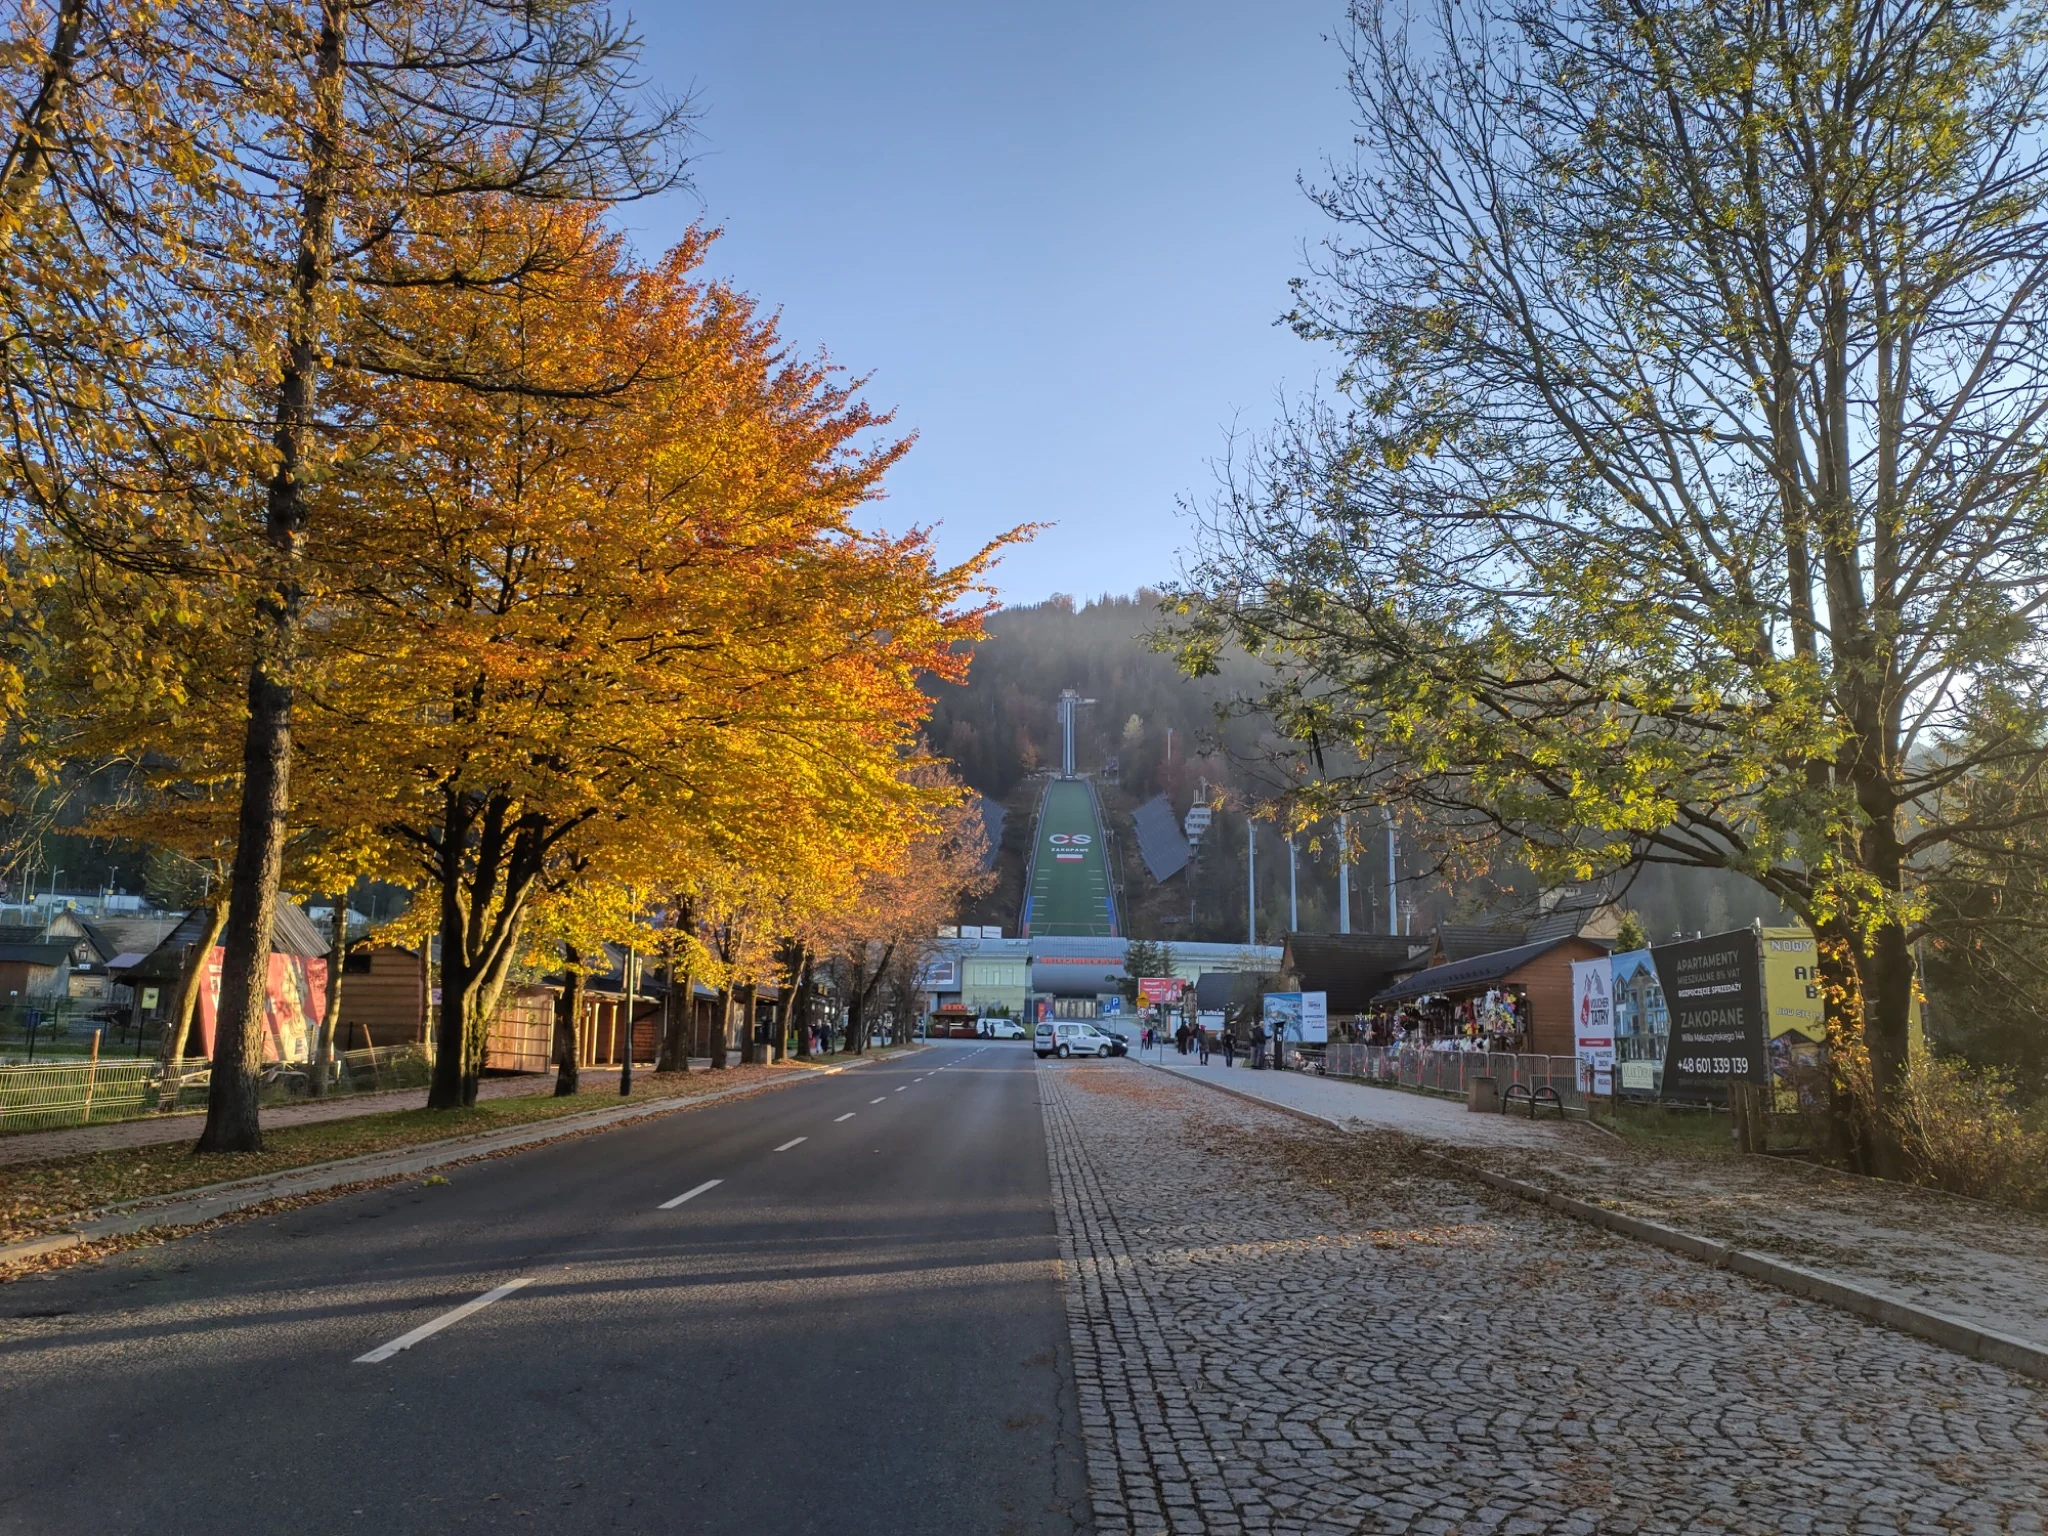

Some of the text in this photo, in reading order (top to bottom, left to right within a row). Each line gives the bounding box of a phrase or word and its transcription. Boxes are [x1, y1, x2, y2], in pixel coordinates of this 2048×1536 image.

[1770, 939, 1813, 952] NOWY
[1677, 950, 1740, 972] APARTAMENTY
[1677, 972, 1715, 985] MIESZKALNE
[1727, 968, 1740, 979] VAT
[1678, 982, 1742, 998] ROZPOCZĘCIE SPRZEDAŻY
[1590, 997, 1609, 1009] VOUCHER
[1139, 1009, 1148, 1018] 30
[1590, 1009, 1609, 1026] TATRY
[1680, 1007, 1745, 1028] ZAKOPANE
[1677, 1057, 1749, 1074] +48 601 339 139
